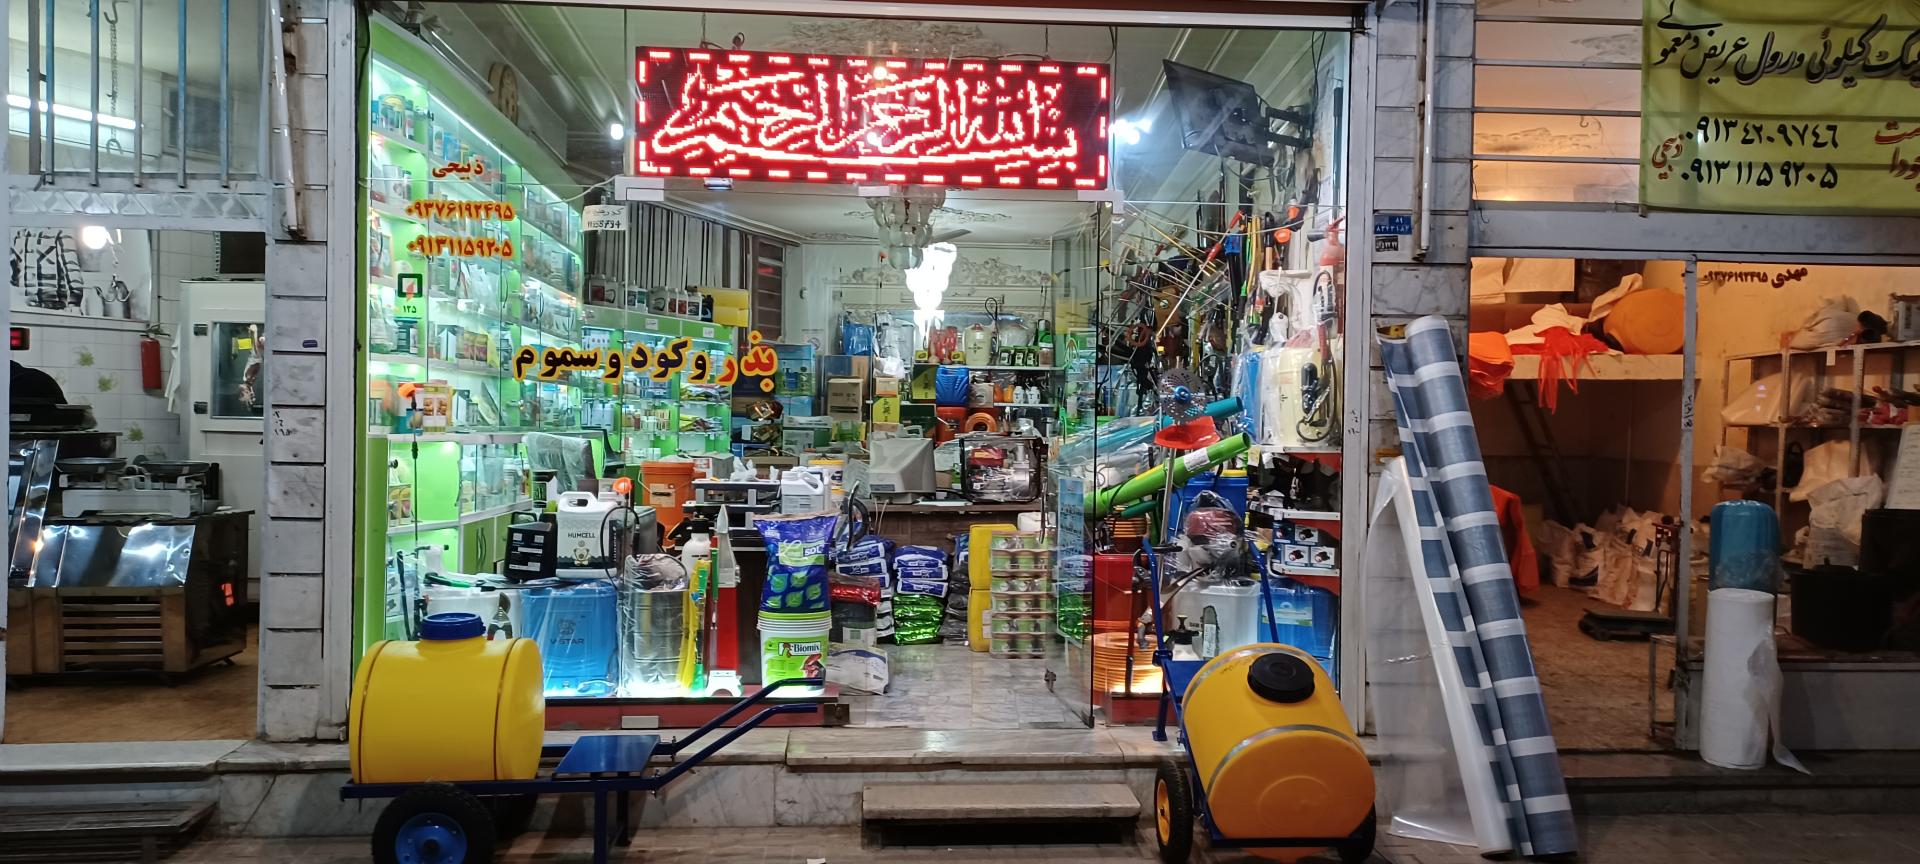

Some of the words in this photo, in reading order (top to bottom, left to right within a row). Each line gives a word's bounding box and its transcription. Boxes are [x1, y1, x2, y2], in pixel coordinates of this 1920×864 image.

[432, 159, 484, 180] ذبیحی
[406, 201, 514, 220] ۰۹۳۷۶۱۹۲۴۹۵
[407, 236, 513, 258] ۰۹۱۳۱۱۵۹۲۰۵
[1771, 267, 1808, 288] مهدی
[402, 304, 418, 315] ۱۲۵
[512, 342, 602, 382] سموم
[598, 346, 623, 382] و
[629, 337, 692, 382] کود
[687, 350, 711, 383] و
[714, 331, 778, 392] بذر
[567, 532, 596, 540] HUMCELL
[794, 643, 820, 653] Biomix
